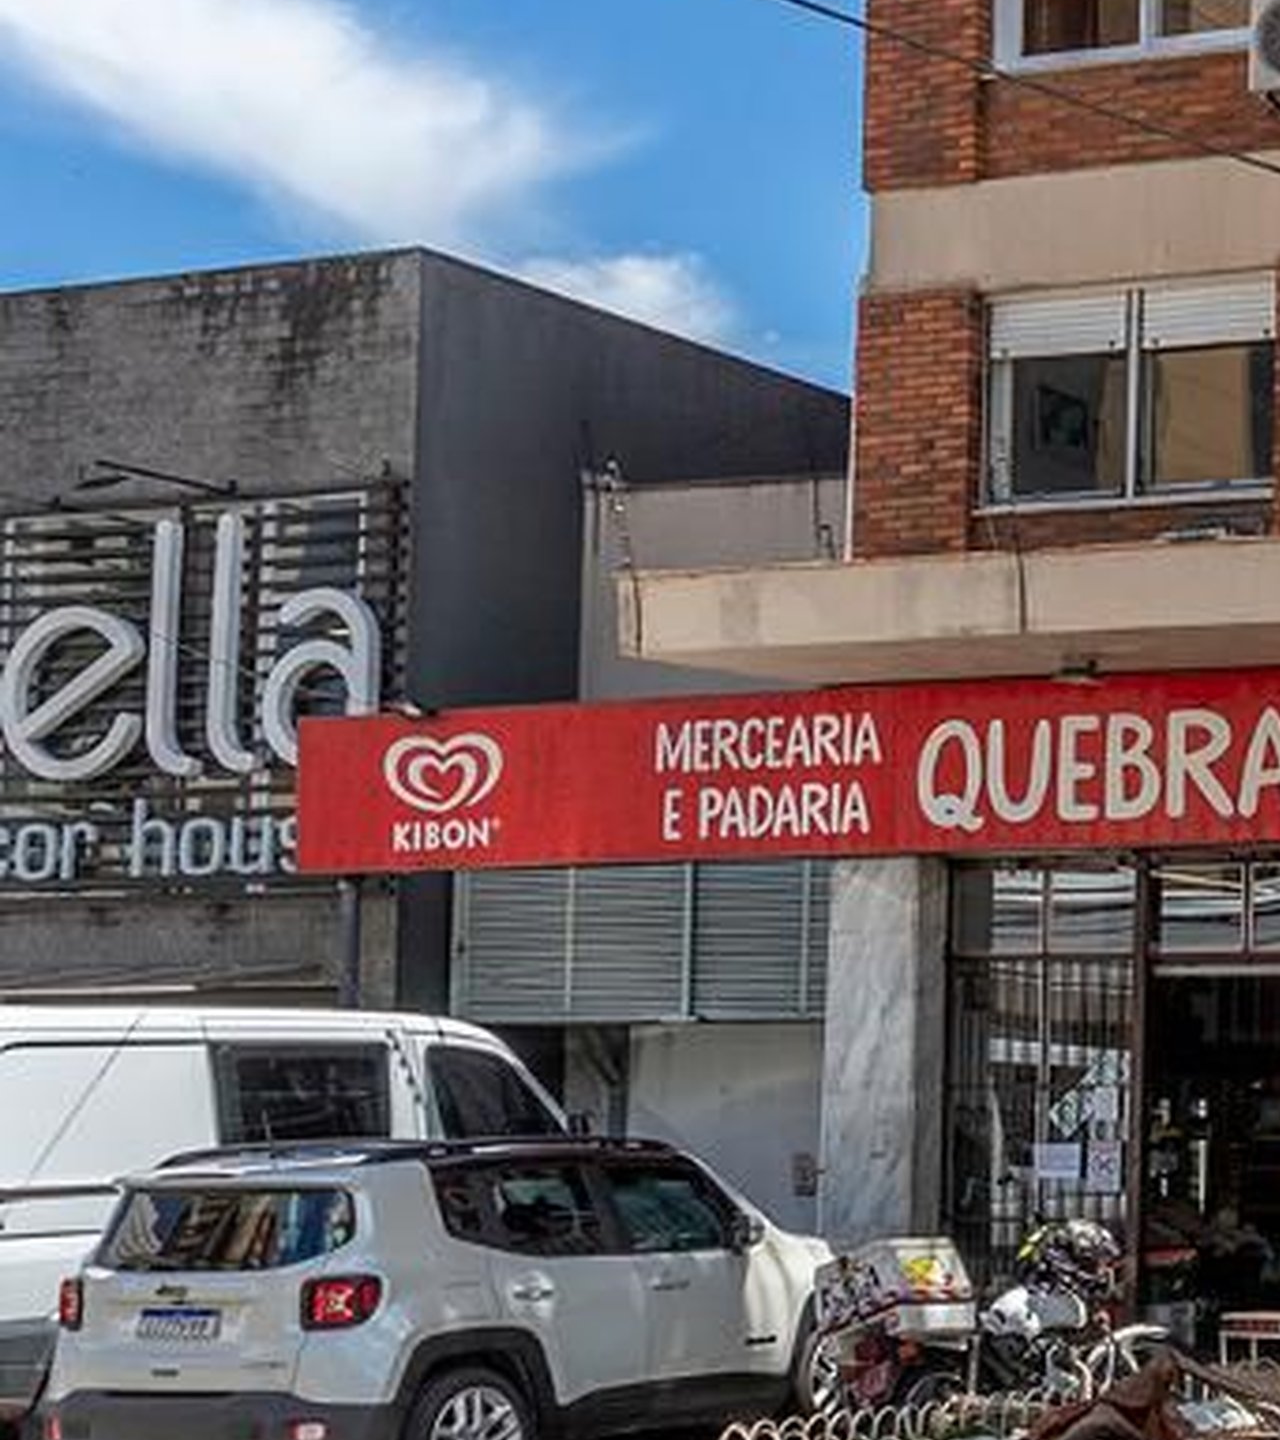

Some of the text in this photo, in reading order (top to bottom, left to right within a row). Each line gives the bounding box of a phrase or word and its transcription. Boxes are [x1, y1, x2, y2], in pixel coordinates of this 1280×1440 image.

[1, 513, 380, 780] ella
[654, 712, 883, 775] MERCEARIA
[662, 781, 872, 841] E PADARIA
